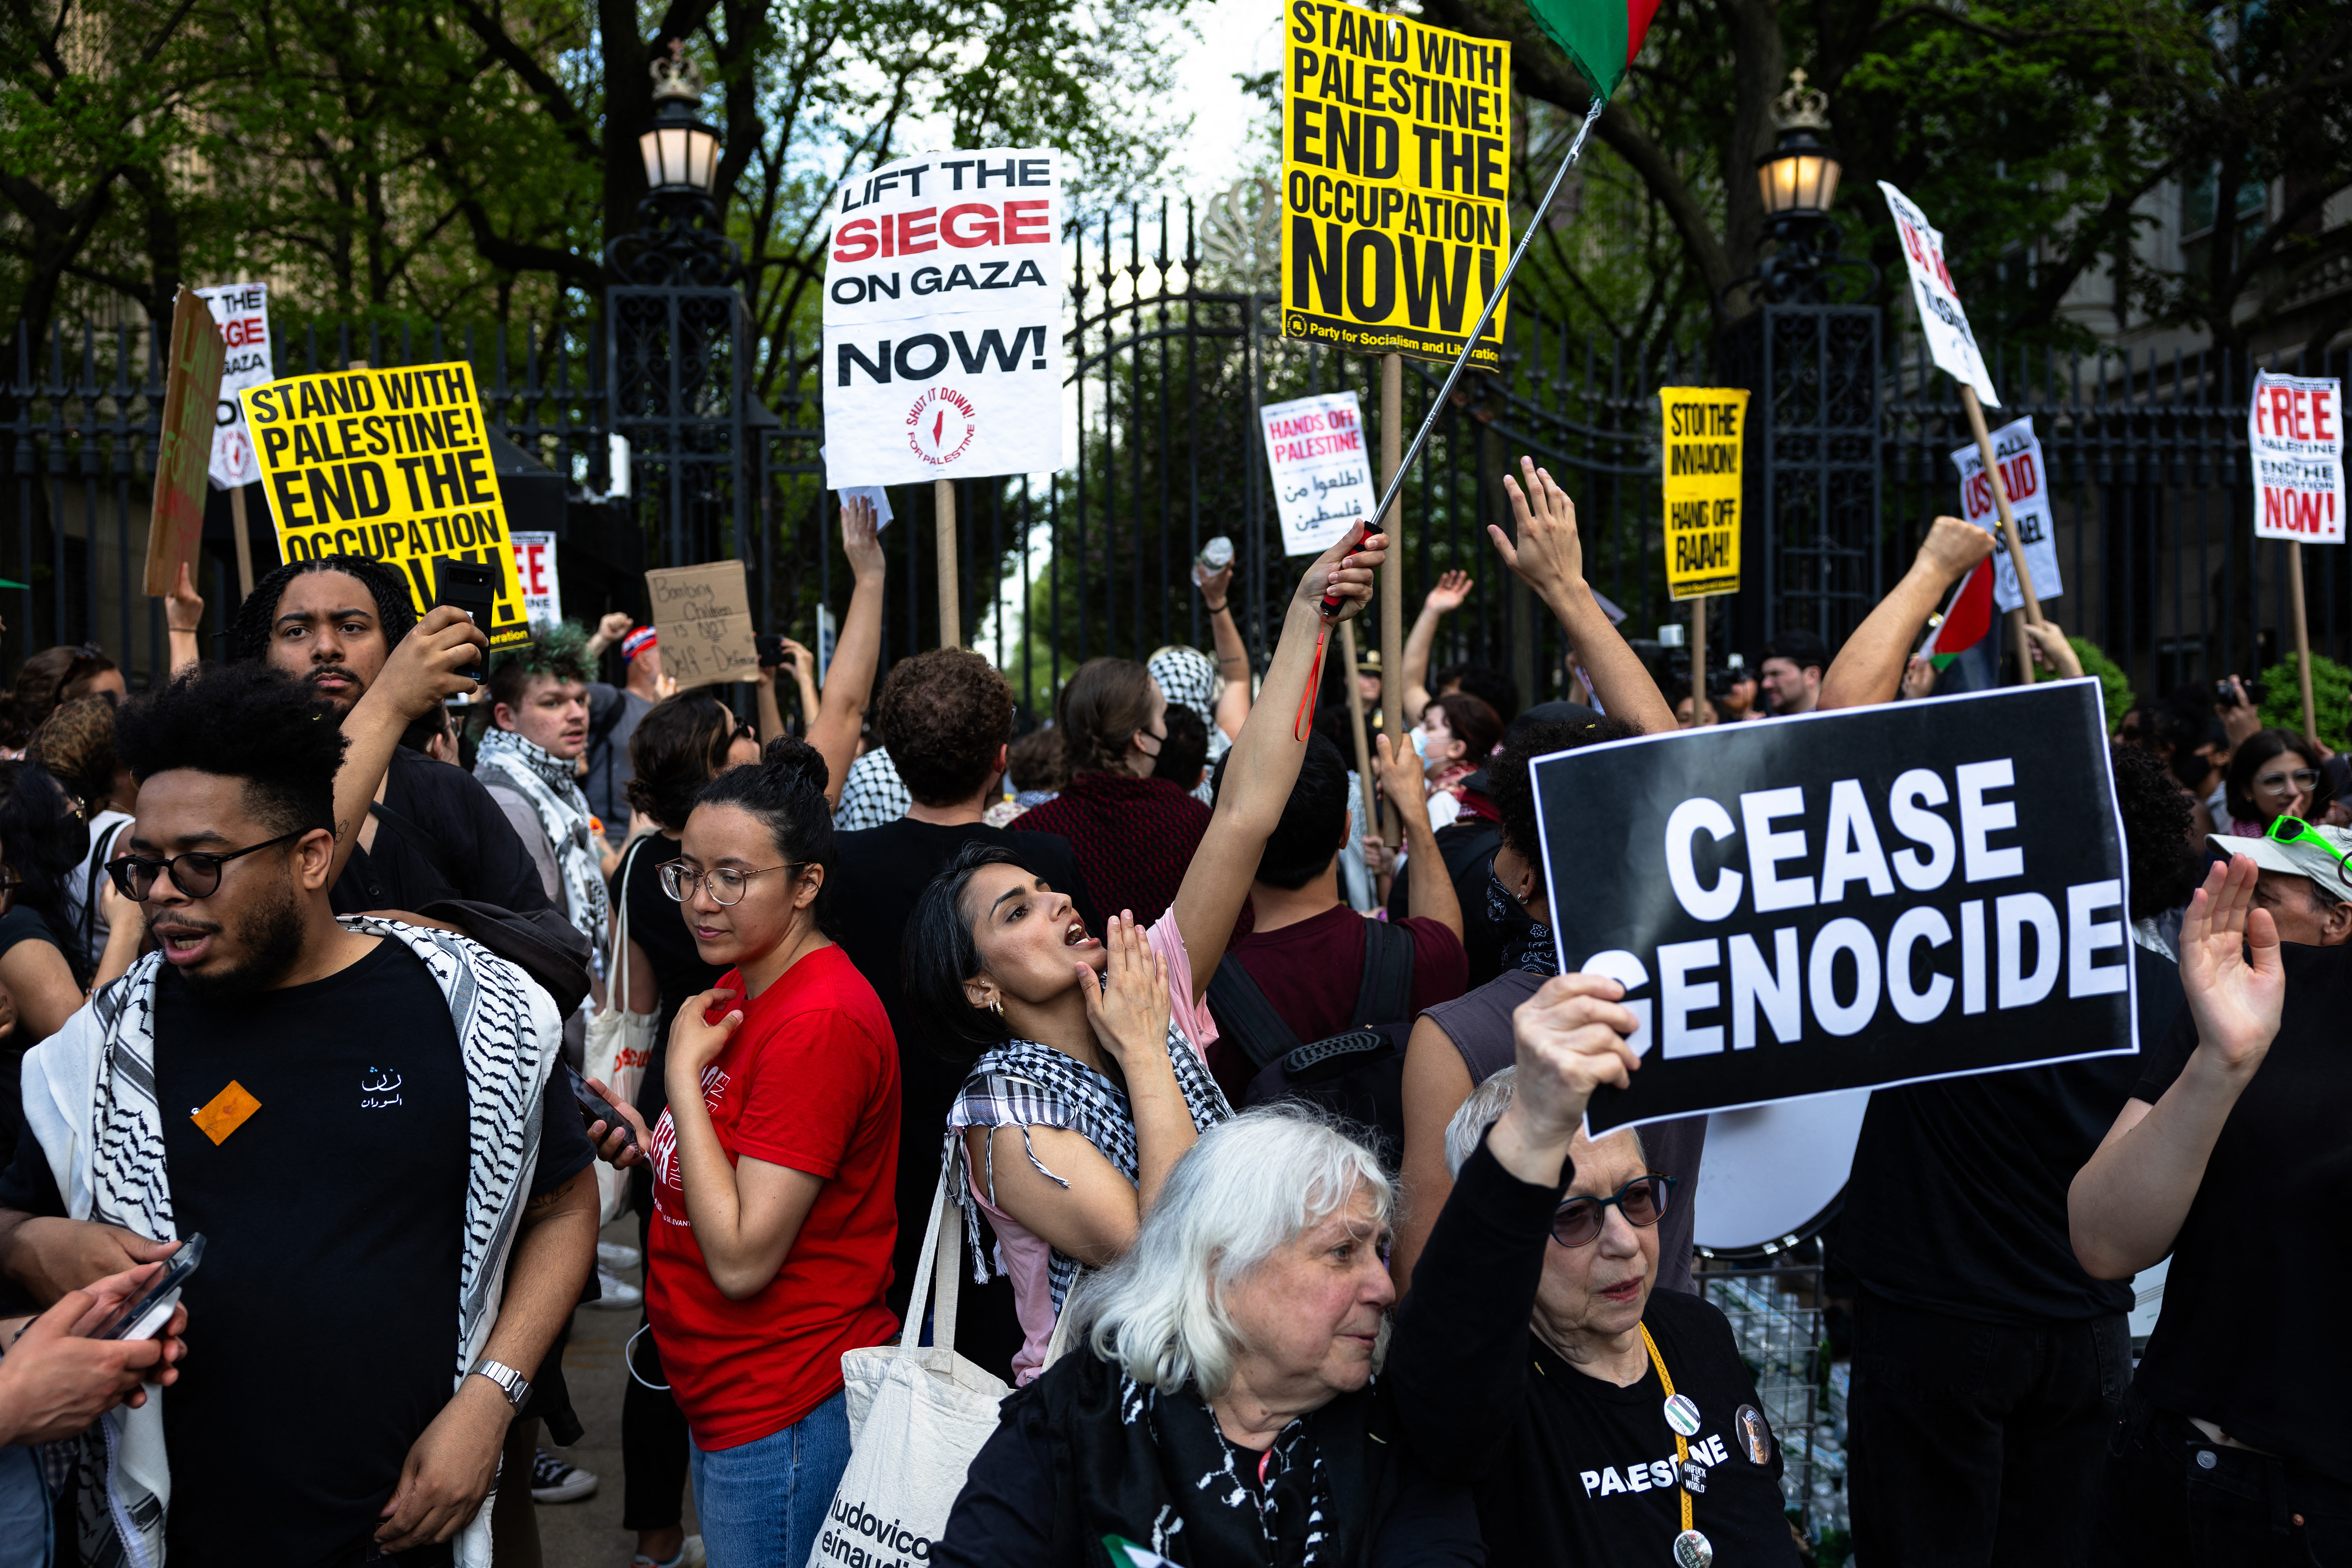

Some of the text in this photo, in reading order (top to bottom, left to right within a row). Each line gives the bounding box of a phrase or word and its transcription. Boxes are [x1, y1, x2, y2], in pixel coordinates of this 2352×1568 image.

[1292, 0, 1502, 88] STAND WITH
[1294, 47, 1503, 136] PALESTINE!
[1293, 97, 1504, 201] END THE
[841, 159, 1051, 214] LIFT THE
[1289, 170, 1500, 247] OCCUPATION
[833, 200, 1050, 263] SIEGE
[831, 260, 1047, 305] ON GAZA
[1292, 215, 1496, 338] NOW!
[223, 291, 261, 314] THE
[838, 325, 1047, 387] NOW!
[1310, 323, 1340, 341] Party
[1342, 329, 1358, 343] for
[1360, 332, 1419, 350] Socialism
[1421, 342, 1444, 354] and
[1447, 343, 1499, 362] Libration
[250, 374, 375, 423] STAND
[378, 367, 470, 410] WITH
[906, 387, 976, 426] SHUT IT DOWN!
[2256, 385, 2335, 441] FREE
[261, 407, 480, 468] PALESTINE!
[1269, 408, 1355, 440] HANDS OFF
[1708, 403, 1739, 436] THE
[908, 424, 975, 465] FOR PALESTINE
[1274, 430, 1361, 464] PALESTINE
[272, 460, 390, 529] END
[397, 449, 495, 513] THE
[2261, 460, 2334, 479] END THE
[1284, 486, 1308, 503] من
[2264, 486, 2336, 534] NOW!
[1296, 499, 1362, 531] فلسطين
[286, 509, 501, 564] OCCUPATION
[490, 630, 528, 644] eration
[697, 619, 728, 640] NOT
[1665, 758, 2024, 922] CEASE
[671, 1218, 690, 1227] LEVANT
[1684, 1397, 1696, 1410] FREE
[1666, 1412, 1688, 1435] PALESTINE
[1684, 1462, 1706, 1478] UNFUCK
[1686, 1479, 1705, 1493] WORLD
[1691, 1473, 1700, 1483] THE
[831, 1489, 932, 1560] ludovico
[822, 1528, 910, 1568] eina
[1679, 1543, 1695, 1568] ILLEGA
[1687, 1546, 1697, 1560] ONE
